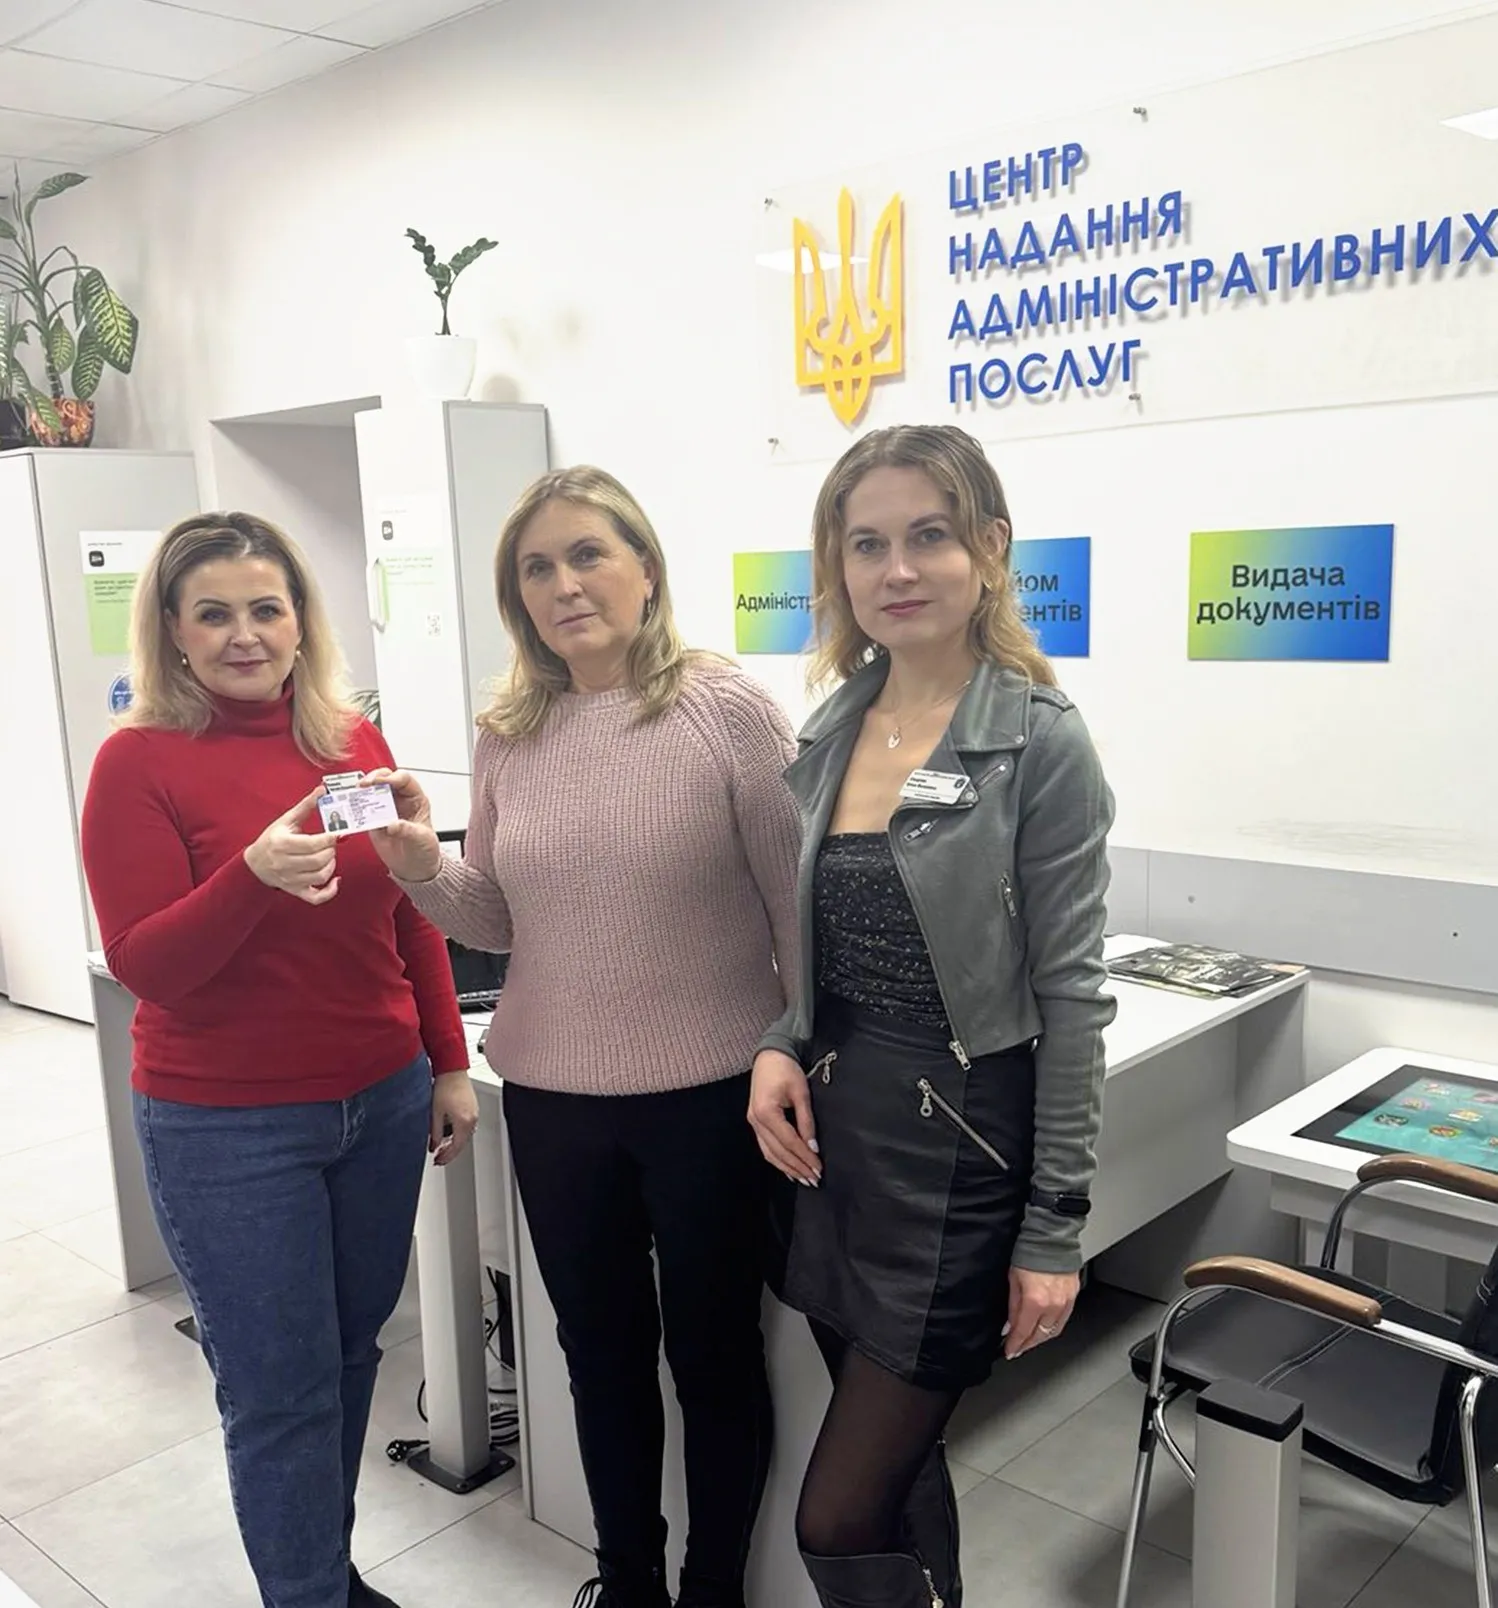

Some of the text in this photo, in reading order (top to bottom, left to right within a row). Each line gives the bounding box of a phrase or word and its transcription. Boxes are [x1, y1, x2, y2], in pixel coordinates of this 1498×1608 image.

[949, 142, 1083, 210] ЦЕНТР
[949, 190, 1182, 275] НАДАННЯ
[948, 208, 1498, 341] АДМІНІСТРАТИВНИХ
[949, 339, 1141, 403] ПОСЛУГ
[1196, 594, 1381, 626] документів
[1231, 564, 1345, 590] Видача
